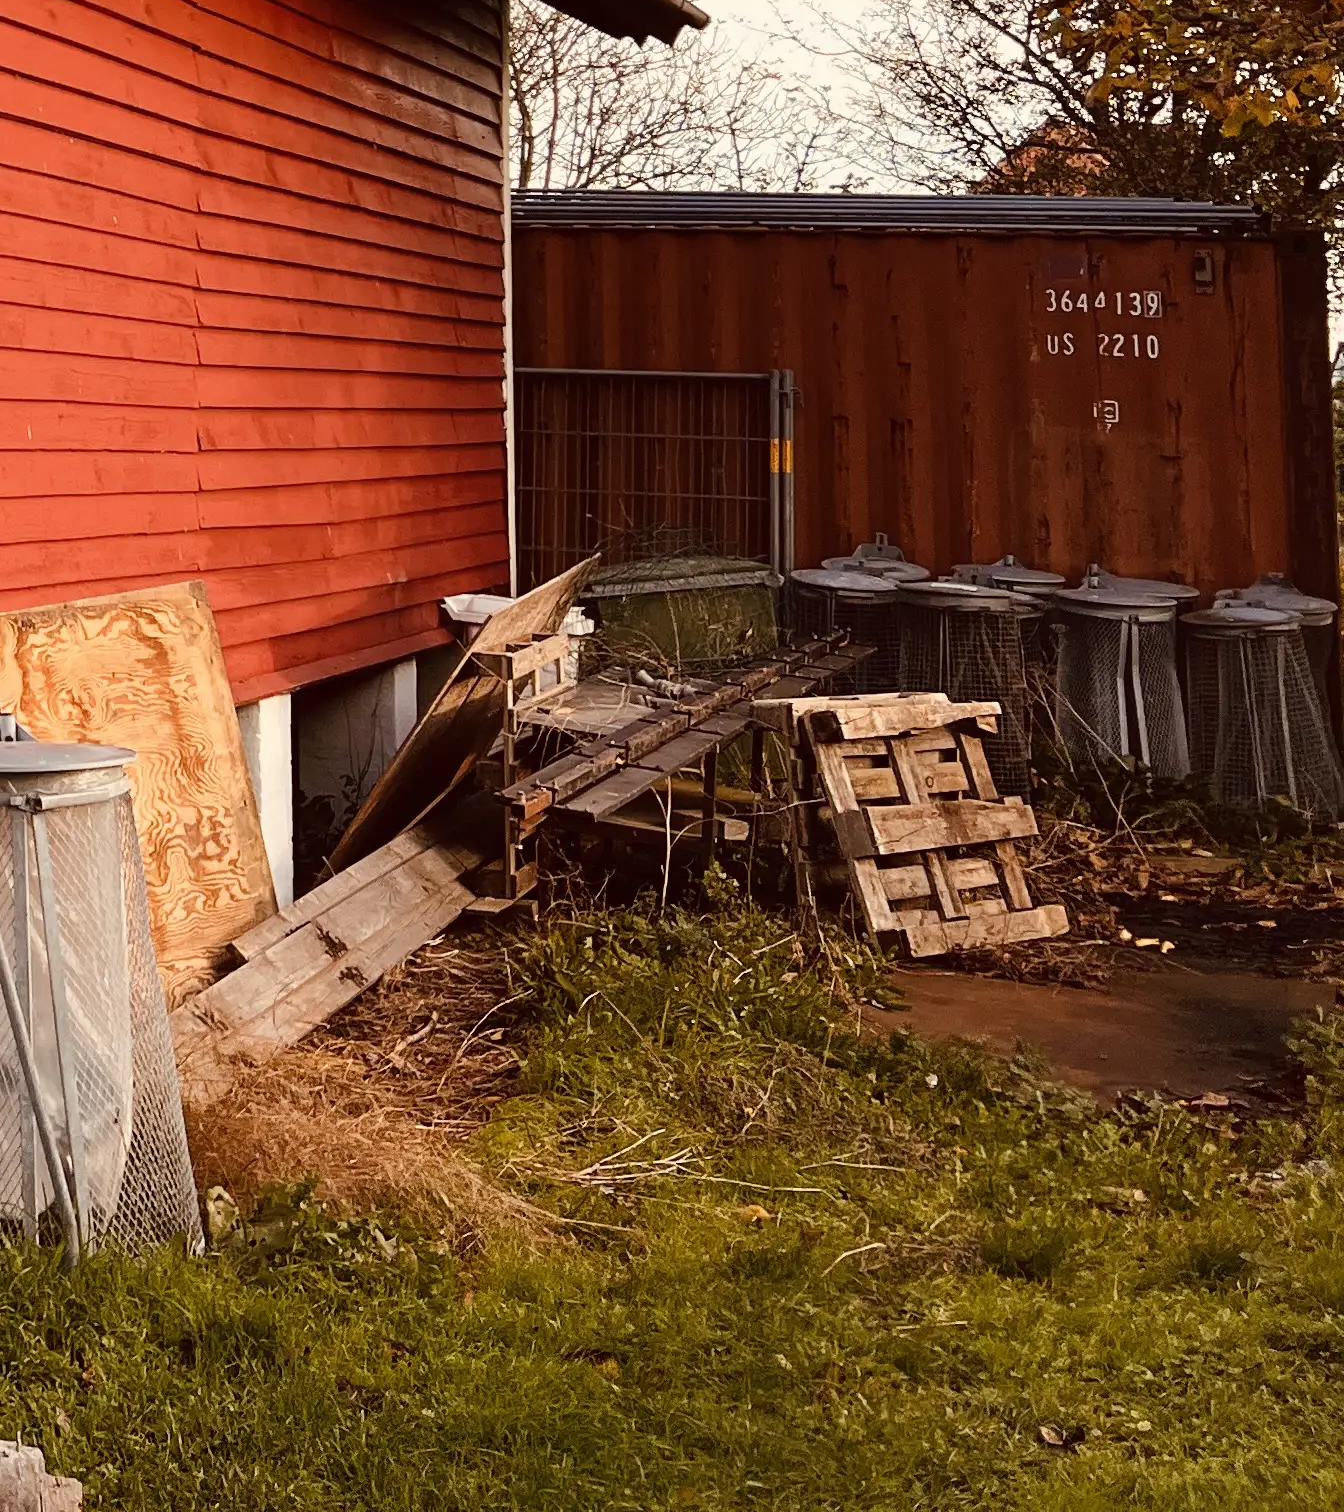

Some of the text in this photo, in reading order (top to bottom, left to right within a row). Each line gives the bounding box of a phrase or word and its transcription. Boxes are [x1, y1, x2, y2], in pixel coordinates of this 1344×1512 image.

[1045, 289, 1161, 317] 3644139
[1047, 332, 1159, 359] US 2210
